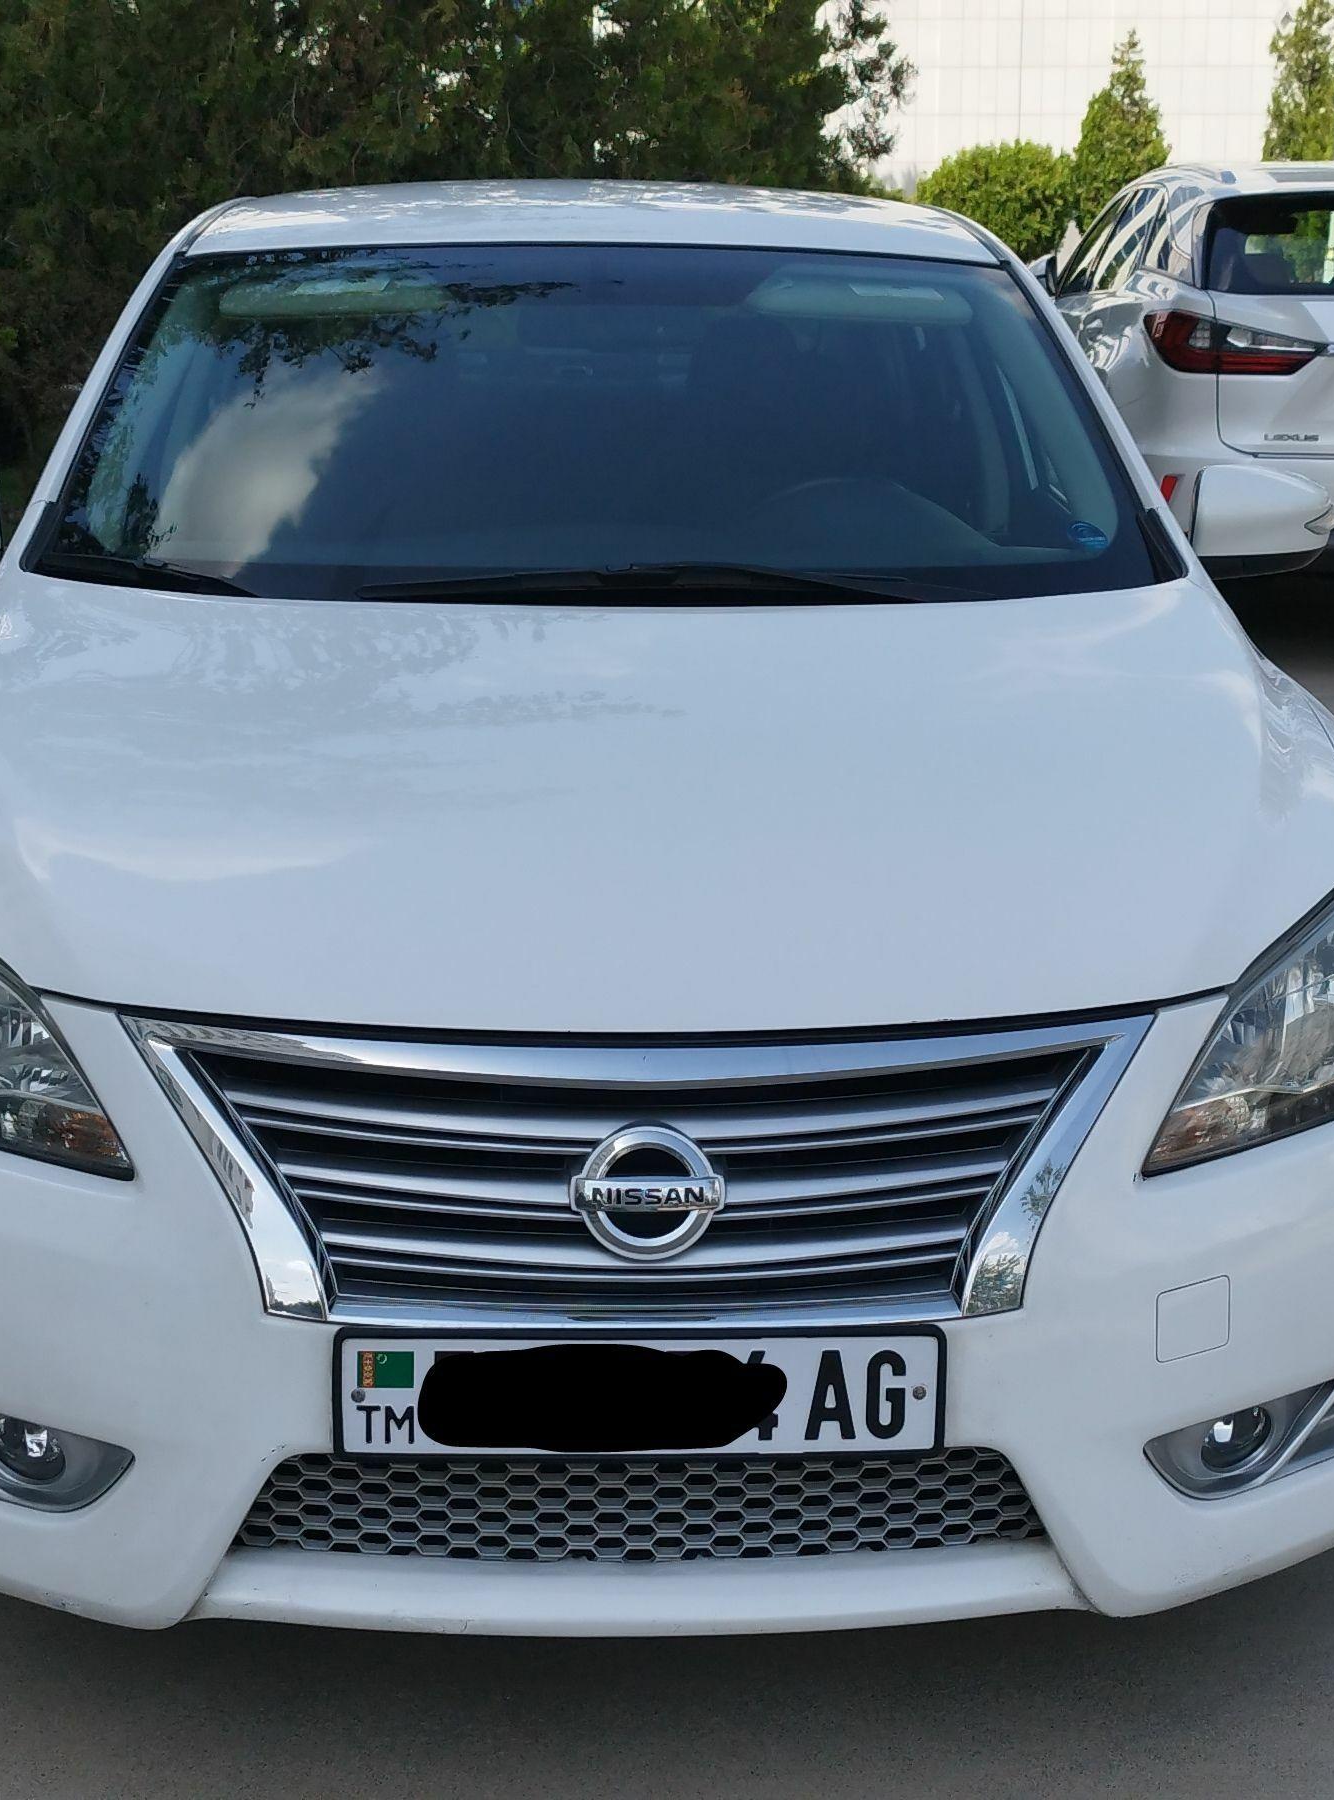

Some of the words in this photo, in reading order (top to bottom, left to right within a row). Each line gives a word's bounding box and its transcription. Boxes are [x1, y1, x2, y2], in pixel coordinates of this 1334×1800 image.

[591, 1186, 704, 1206] NISSAN
[804, 1350, 906, 1440] AG
[356, 1405, 415, 1444] TM
